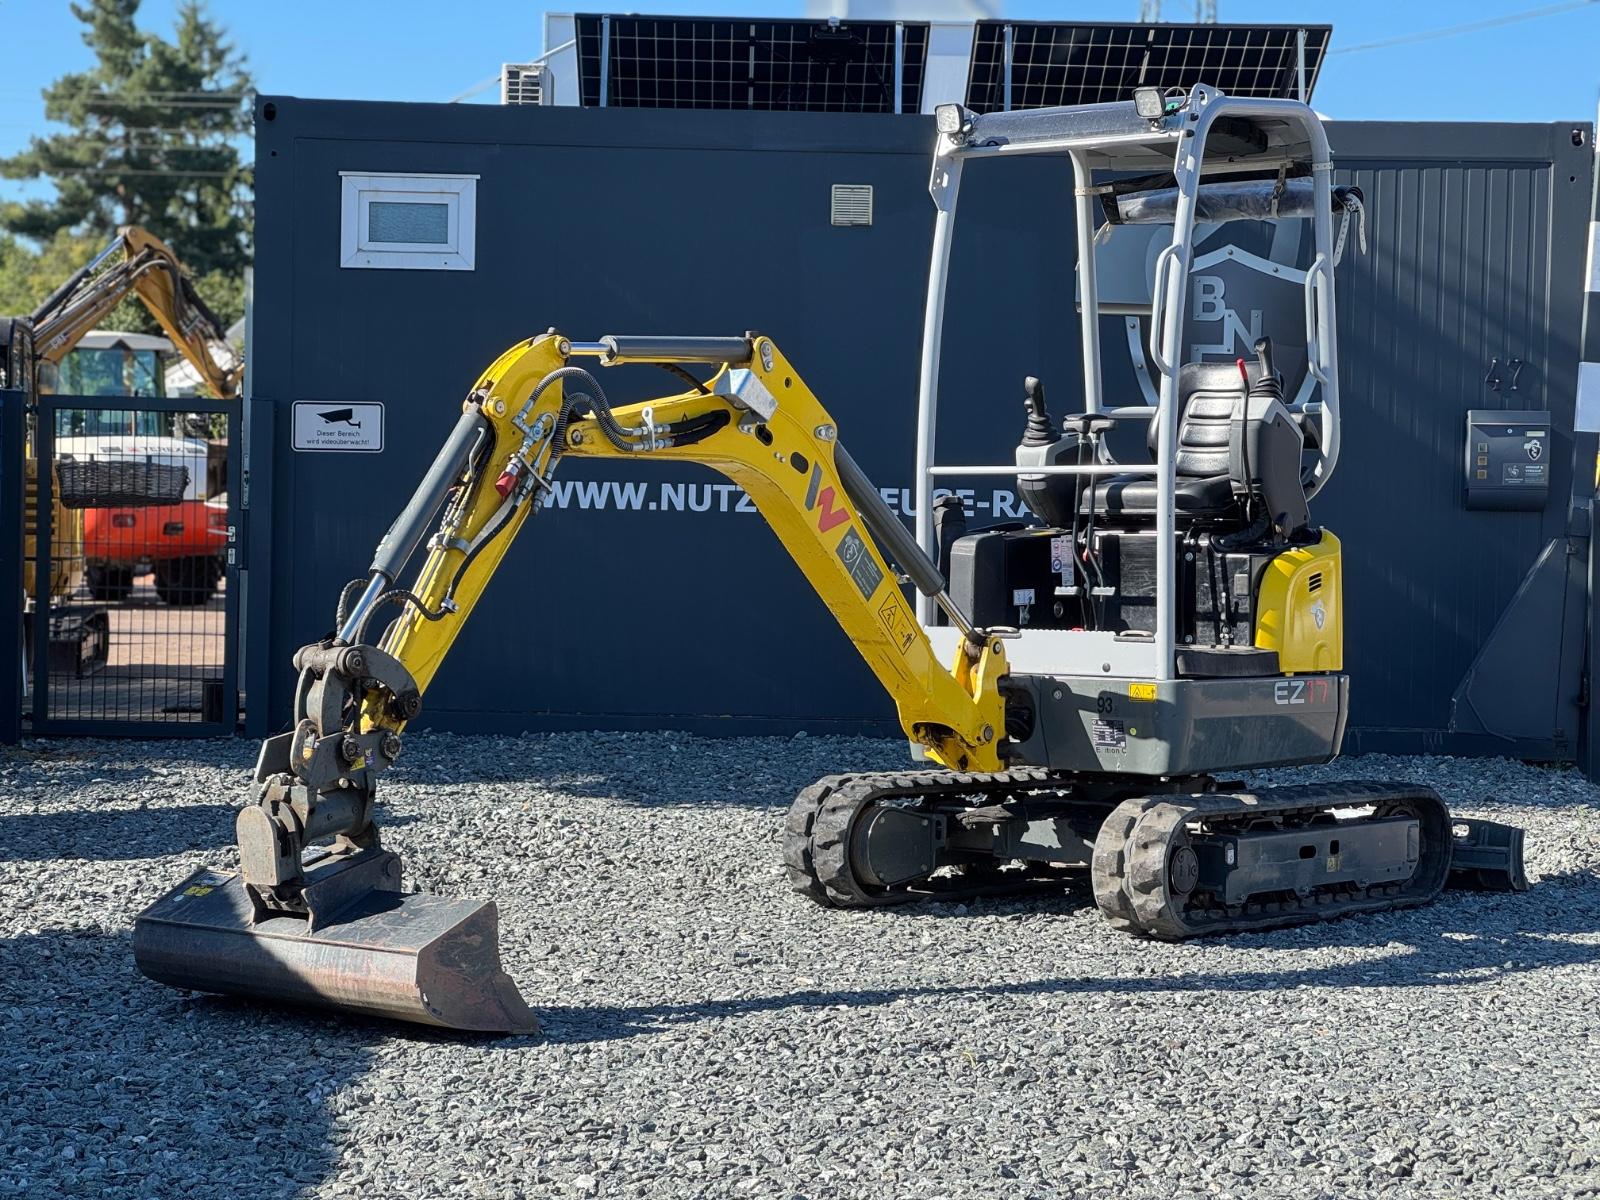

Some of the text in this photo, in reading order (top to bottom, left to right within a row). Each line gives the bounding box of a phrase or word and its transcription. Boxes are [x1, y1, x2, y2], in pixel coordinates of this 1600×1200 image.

[337, 430, 361, 438] Bereich
[1274, 679, 1329, 705] EZ17
[1097, 696, 1113, 714] 93
